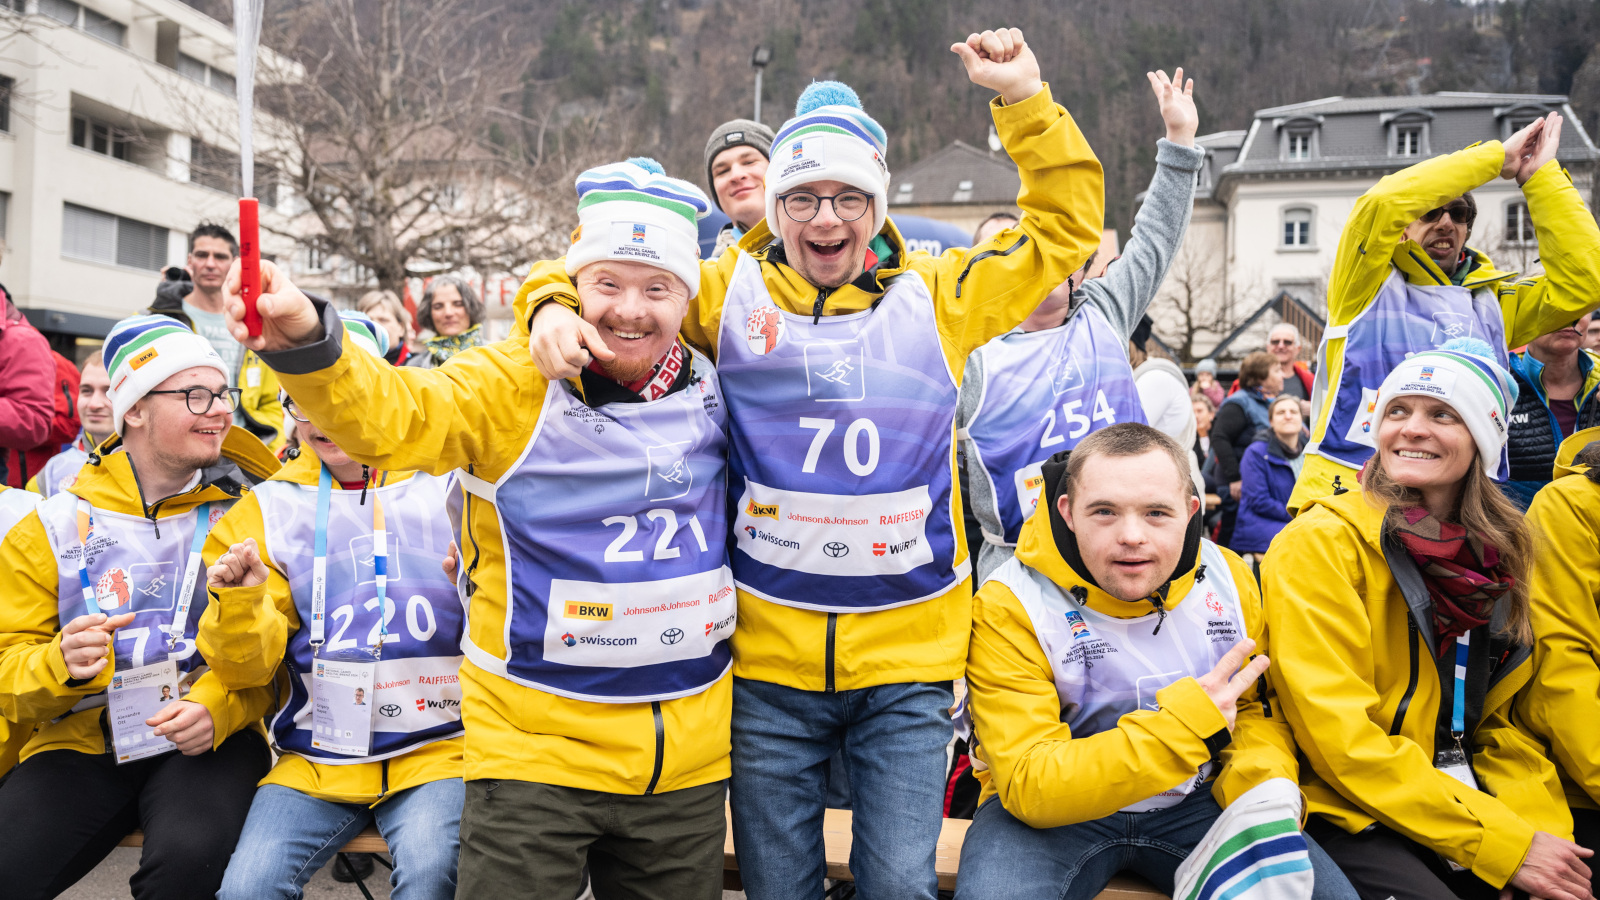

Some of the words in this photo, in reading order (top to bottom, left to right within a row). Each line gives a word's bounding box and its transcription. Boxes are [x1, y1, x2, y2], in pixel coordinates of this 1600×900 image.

[139, 351, 154, 363] BKW
[563, 410, 594, 419] HASLITAL
[1040, 389, 1117, 449] 254
[1510, 413, 1529, 425] KW
[799, 417, 881, 477] 70
[752, 505, 777, 516] BKW
[879, 508, 924, 526] RAIFFEISEN
[787, 512, 869, 526] Johnson&Johnson
[601, 508, 709, 563] 221
[757, 530, 800, 550] swisscom
[578, 605, 609, 618] BKW
[623, 599, 701, 617] Johnson&Johnson
[326, 594, 437, 653] 220
[1206, 628, 1237, 636] Olympics
[580, 635, 638, 646] swisscom
[374, 679, 411, 691] &Johnson
